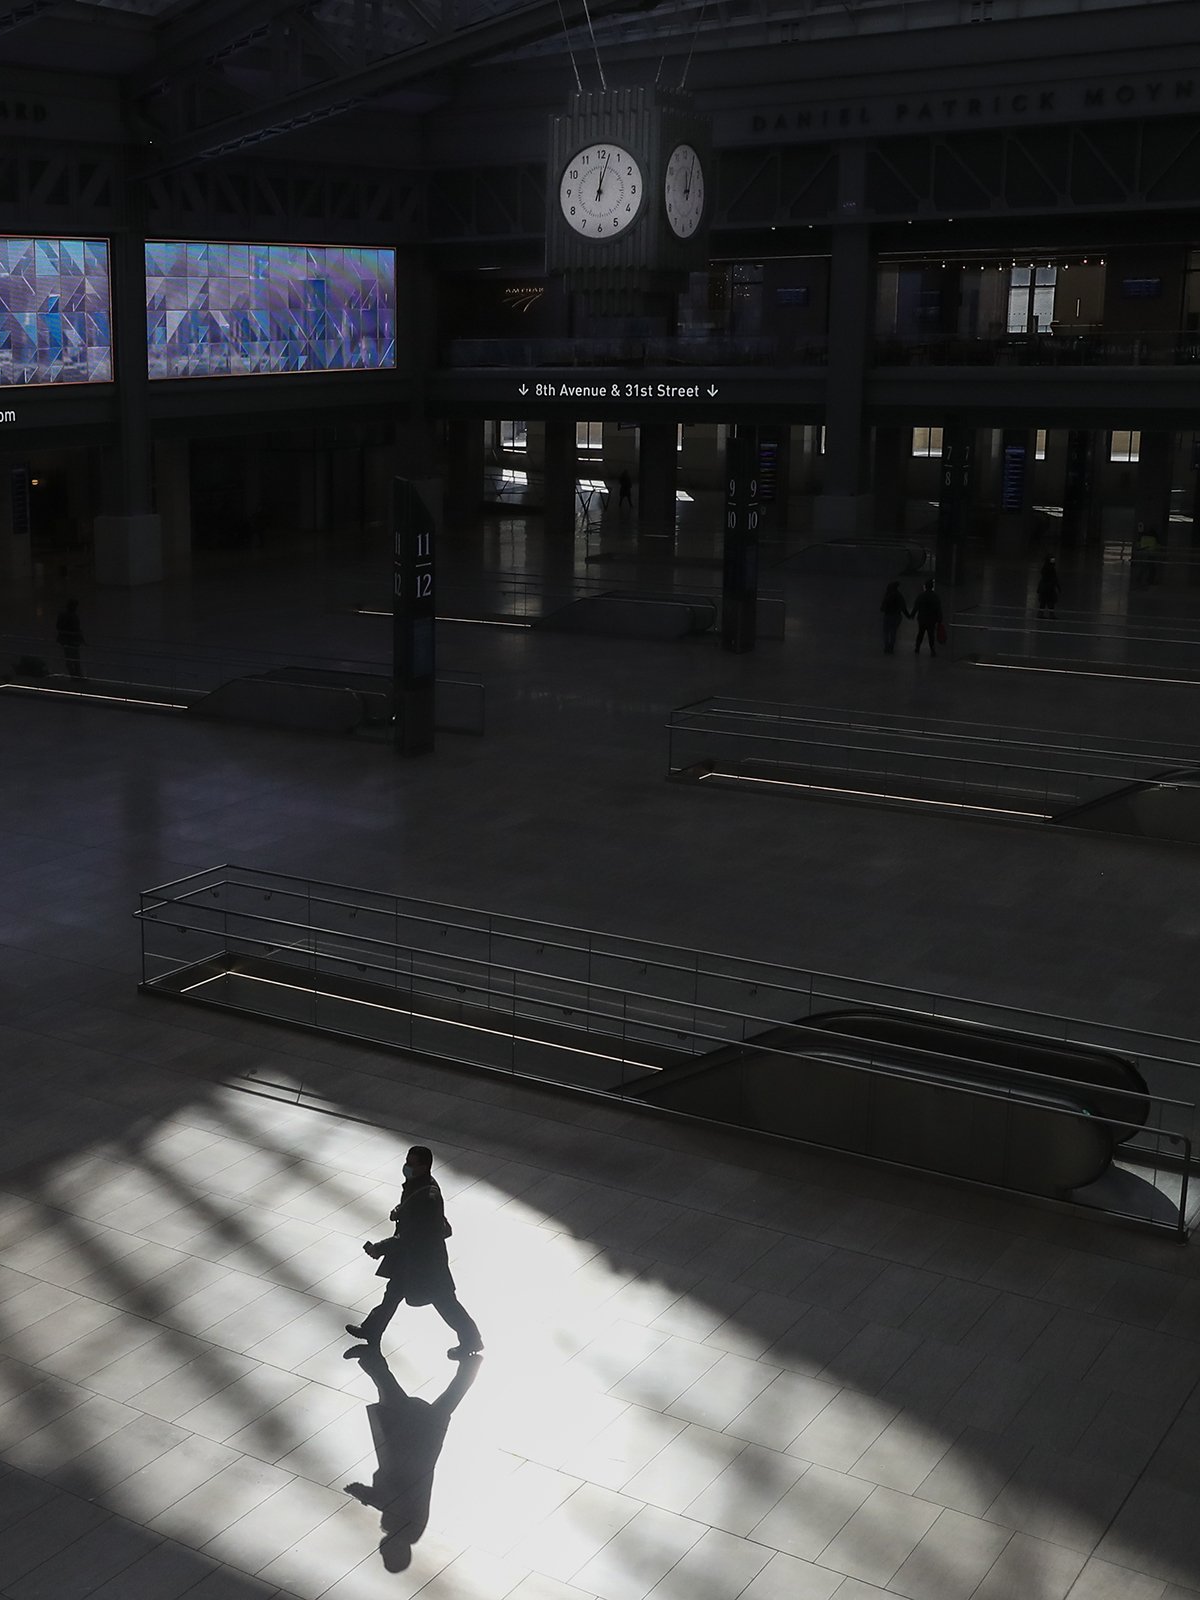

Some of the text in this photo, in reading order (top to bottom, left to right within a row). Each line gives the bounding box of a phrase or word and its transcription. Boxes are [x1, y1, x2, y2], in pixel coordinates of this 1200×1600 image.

[753, 107, 871, 132] DANIEL
[897, 91, 1056, 122] PATRICK
[597, 150, 606, 159] 12
[582, 156, 589, 164] 11
[570, 170, 578, 179] 10
[628, 166, 632, 175] 2
[566, 189, 571, 198] 9
[631, 185, 636, 194] 3
[570, 206, 576, 215] 8
[626, 204, 631, 212] 4
[582, 219, 586, 228] 7
[613, 218, 618, 227] 5
[598, 224, 602, 232] 6
[535, 384, 700, 397] 8th Avenue & 31st Street
[730, 480, 736, 496] 9
[750, 480, 757, 498] 9
[728, 511, 736, 528] 10
[748, 511, 758, 530] 10
[417, 532, 430, 556] 11
[416, 574, 432, 598] 12
